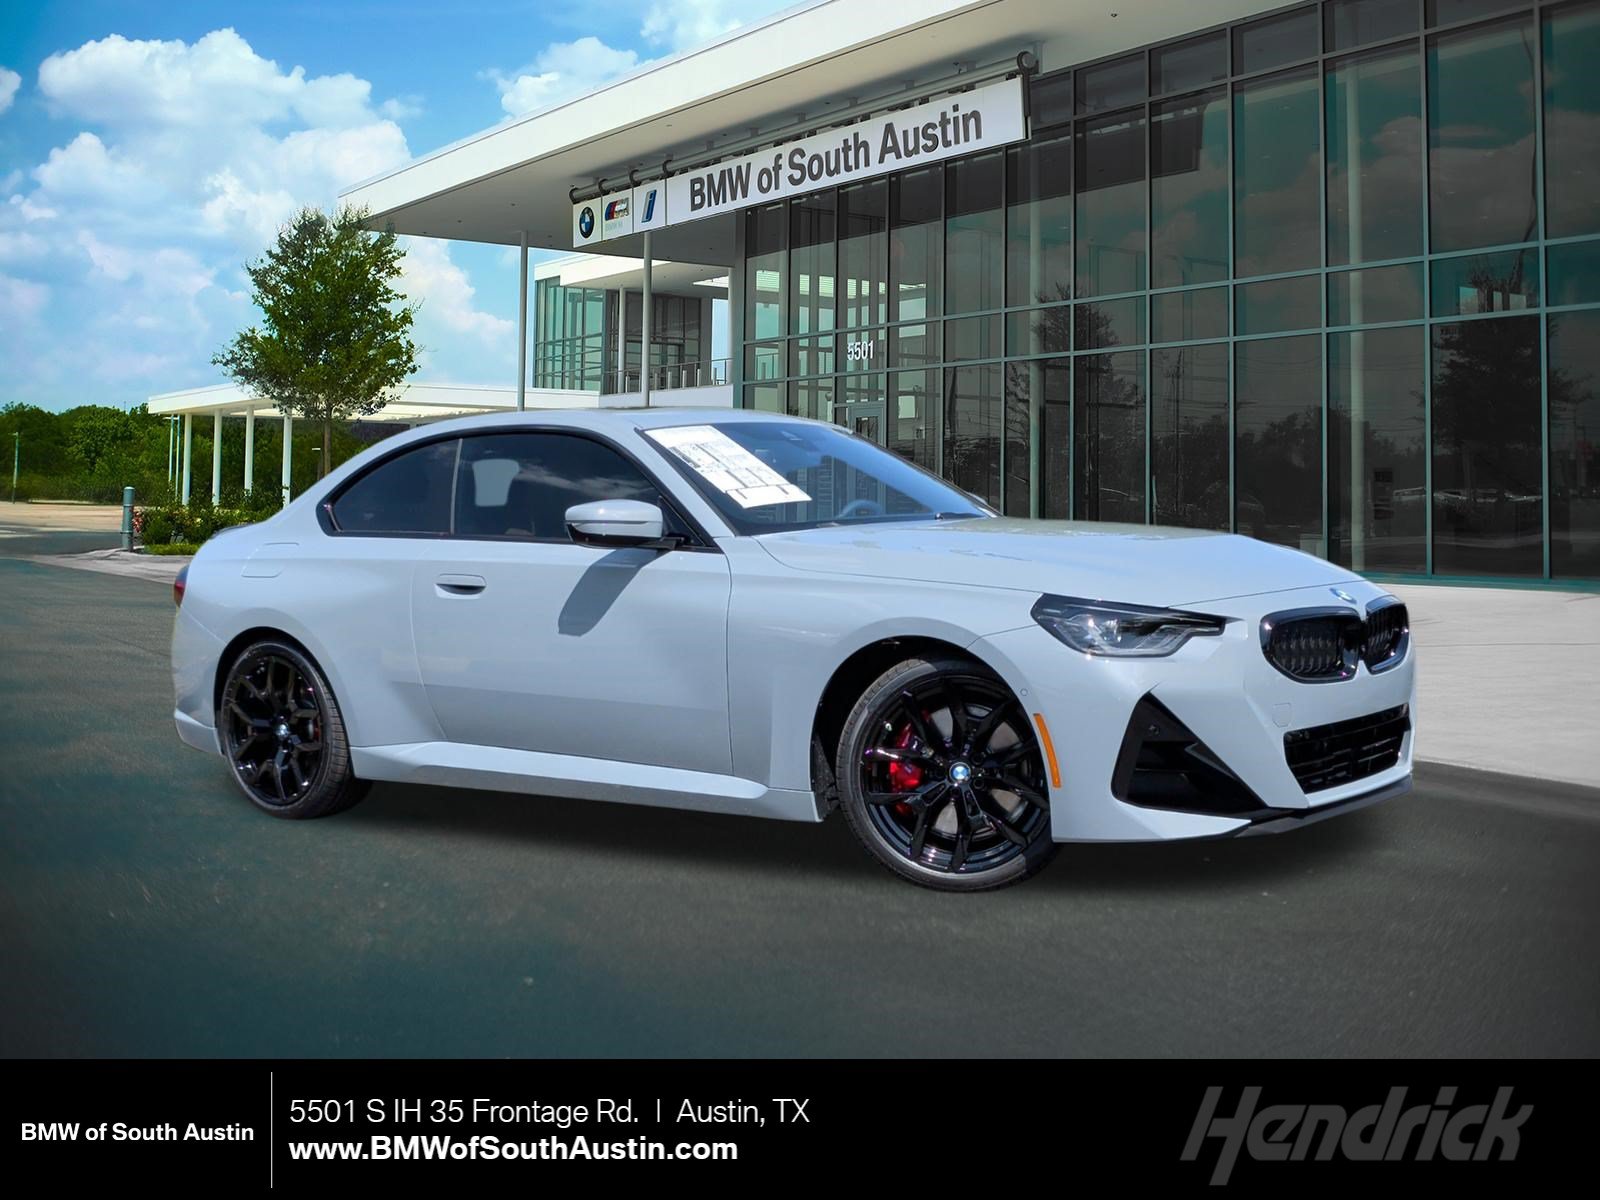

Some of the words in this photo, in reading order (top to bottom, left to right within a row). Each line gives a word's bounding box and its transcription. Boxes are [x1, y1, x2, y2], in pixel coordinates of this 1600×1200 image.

[689, 162, 752, 212] BMW
[757, 153, 783, 194] of
[787, 132, 871, 187] South
[878, 103, 982, 164] Austin
[847, 340, 874, 361] 5501
